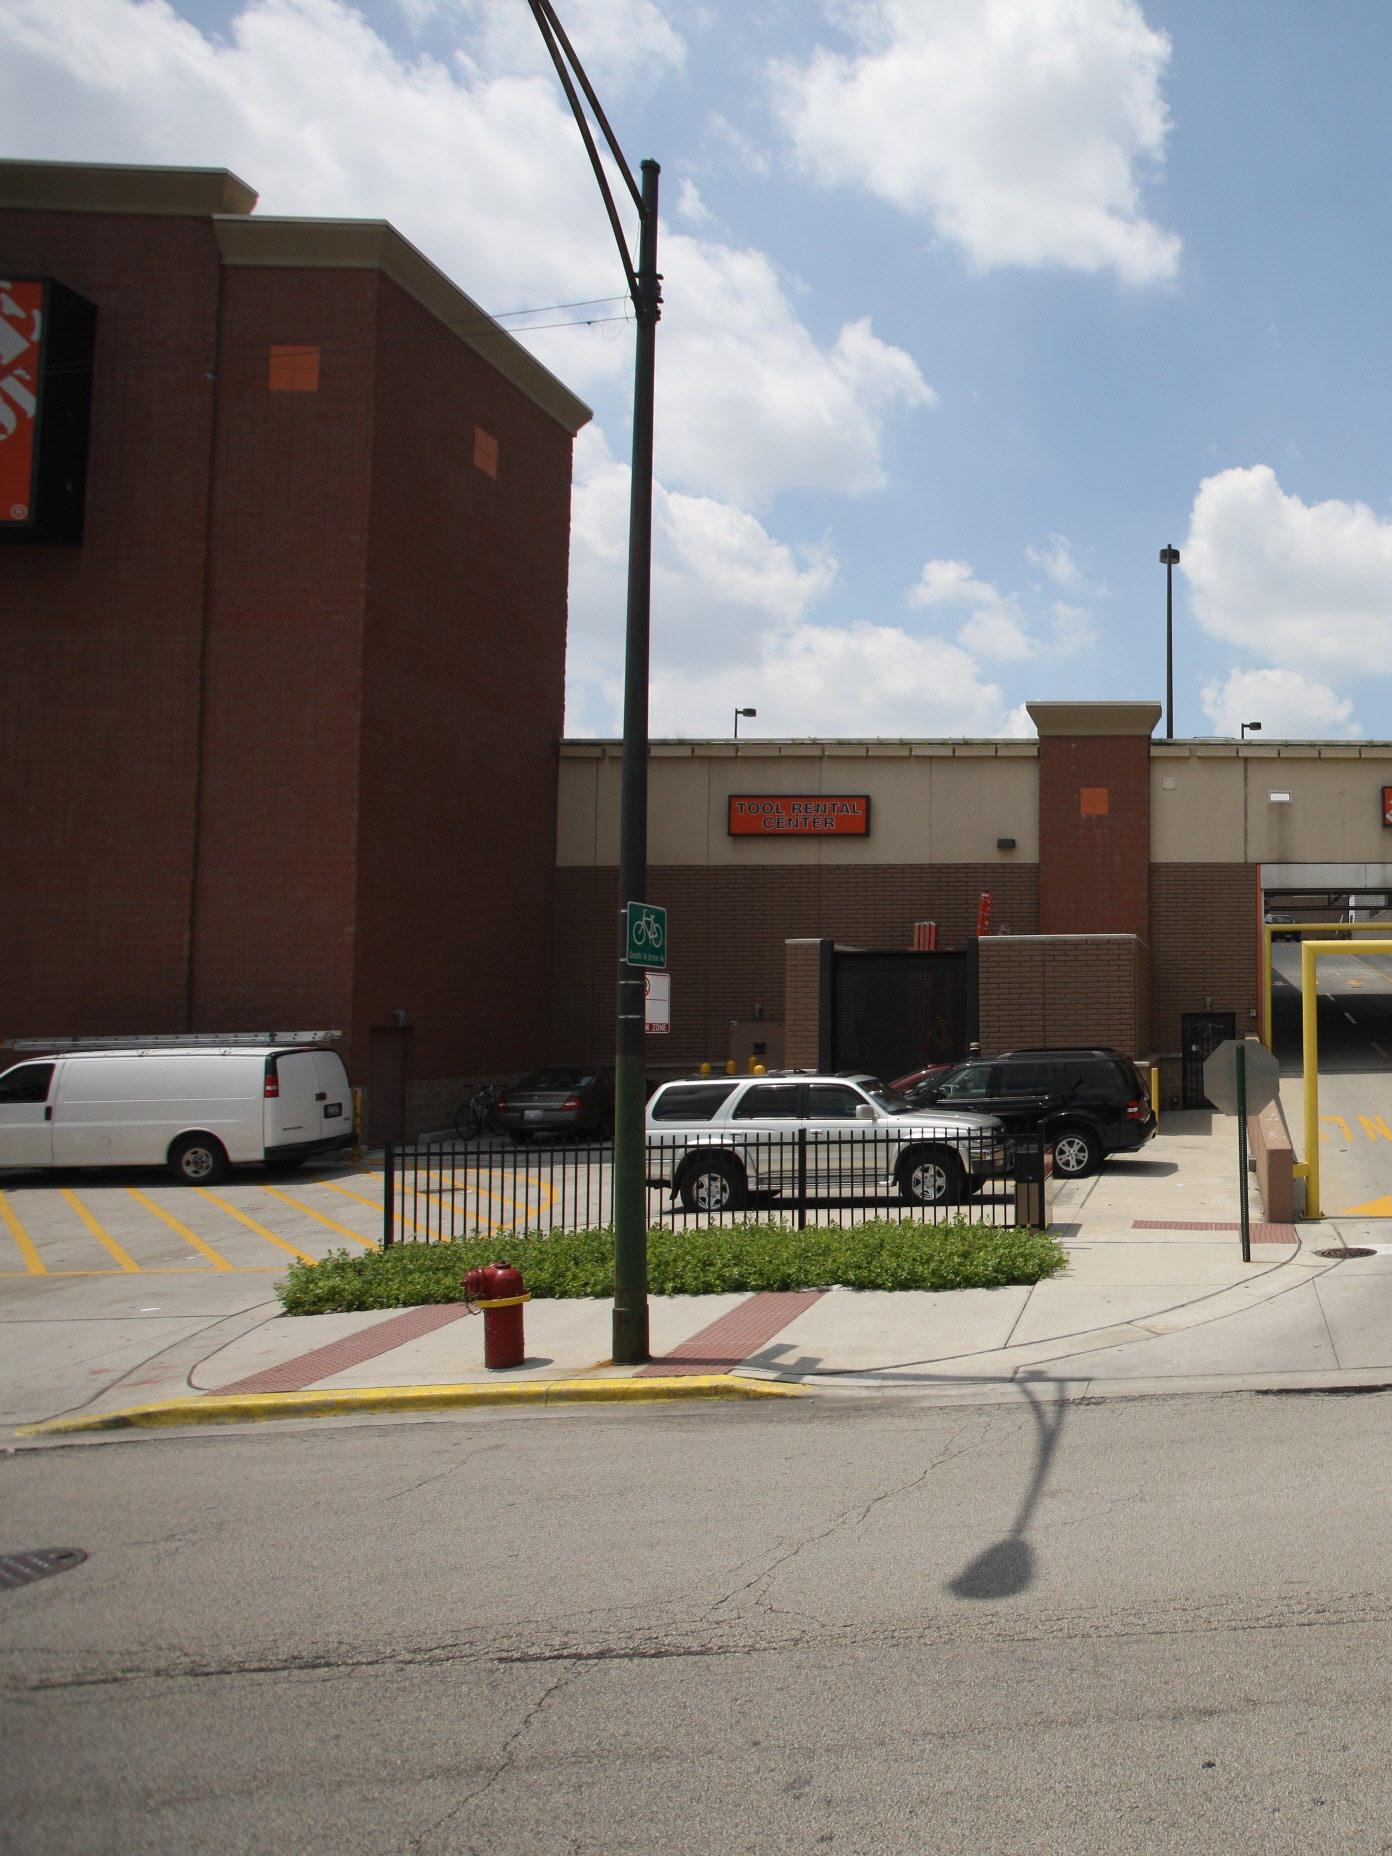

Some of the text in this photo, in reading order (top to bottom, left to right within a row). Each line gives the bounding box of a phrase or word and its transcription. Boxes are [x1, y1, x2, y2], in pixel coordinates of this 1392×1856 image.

[736, 801, 862, 815] TOOL RENTAL
[763, 816, 836, 830] CENTER
[652, 1023, 667, 1032] ZONE
